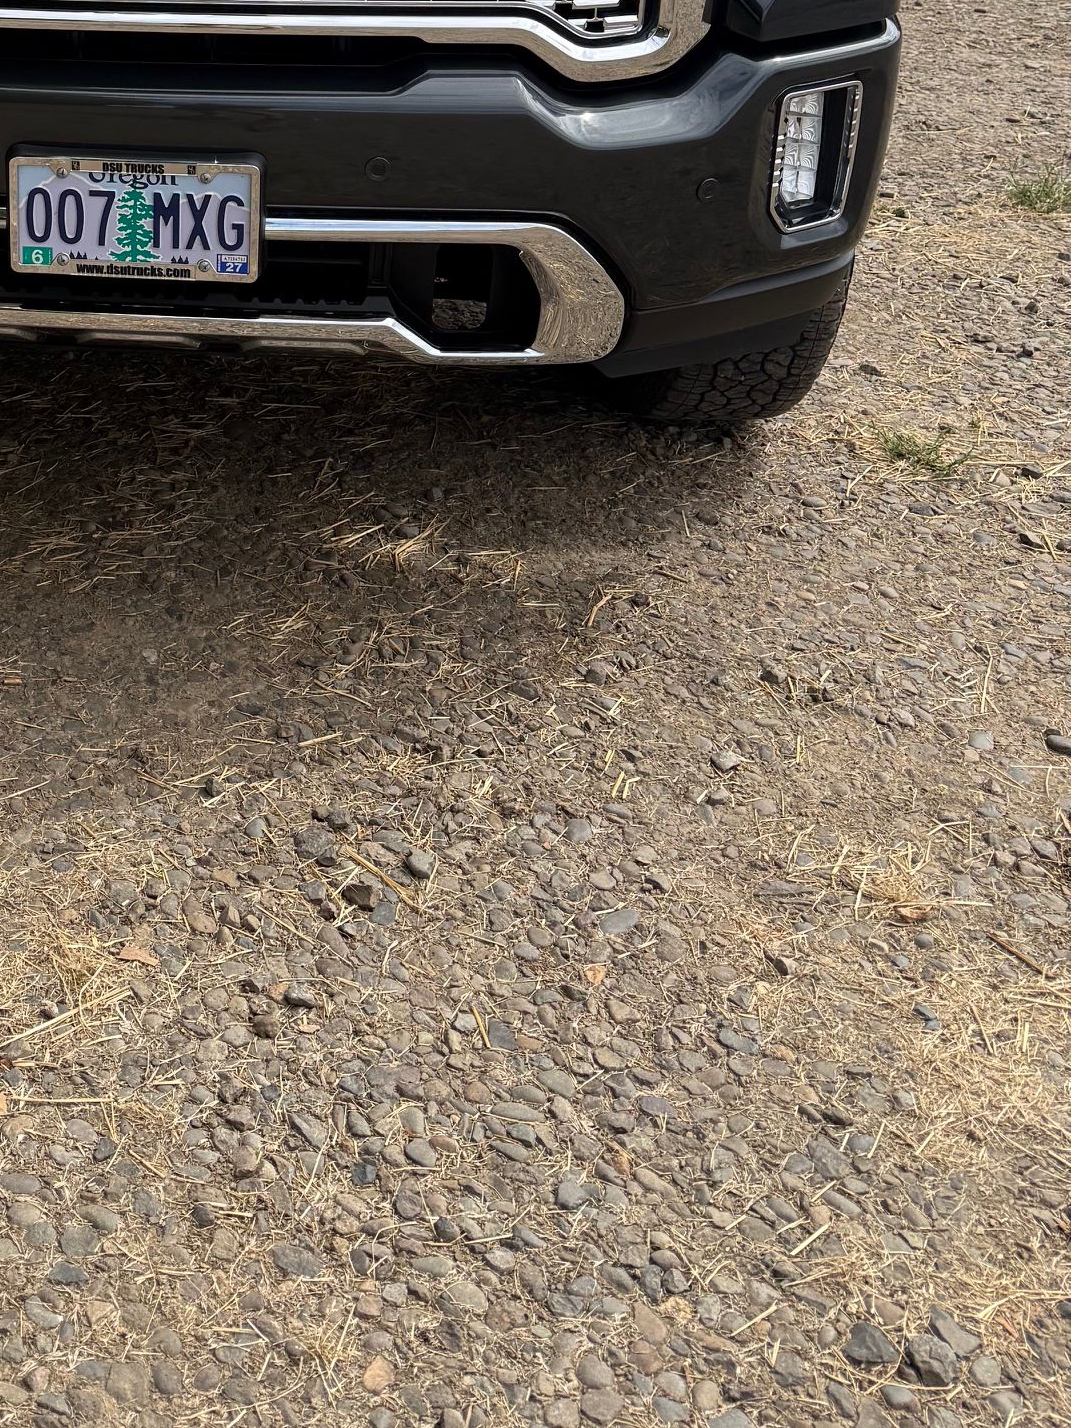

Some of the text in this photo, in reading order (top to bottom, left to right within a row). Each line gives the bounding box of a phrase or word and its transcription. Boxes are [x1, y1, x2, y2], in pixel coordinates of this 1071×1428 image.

[102, 162, 165, 175] DSU TRUCKS
[26, 186, 246, 252] 007 MXG
[31, 249, 44, 265] 6
[76, 262, 192, 279] www.dsutrucks.com
[225, 262, 243, 273] 27
